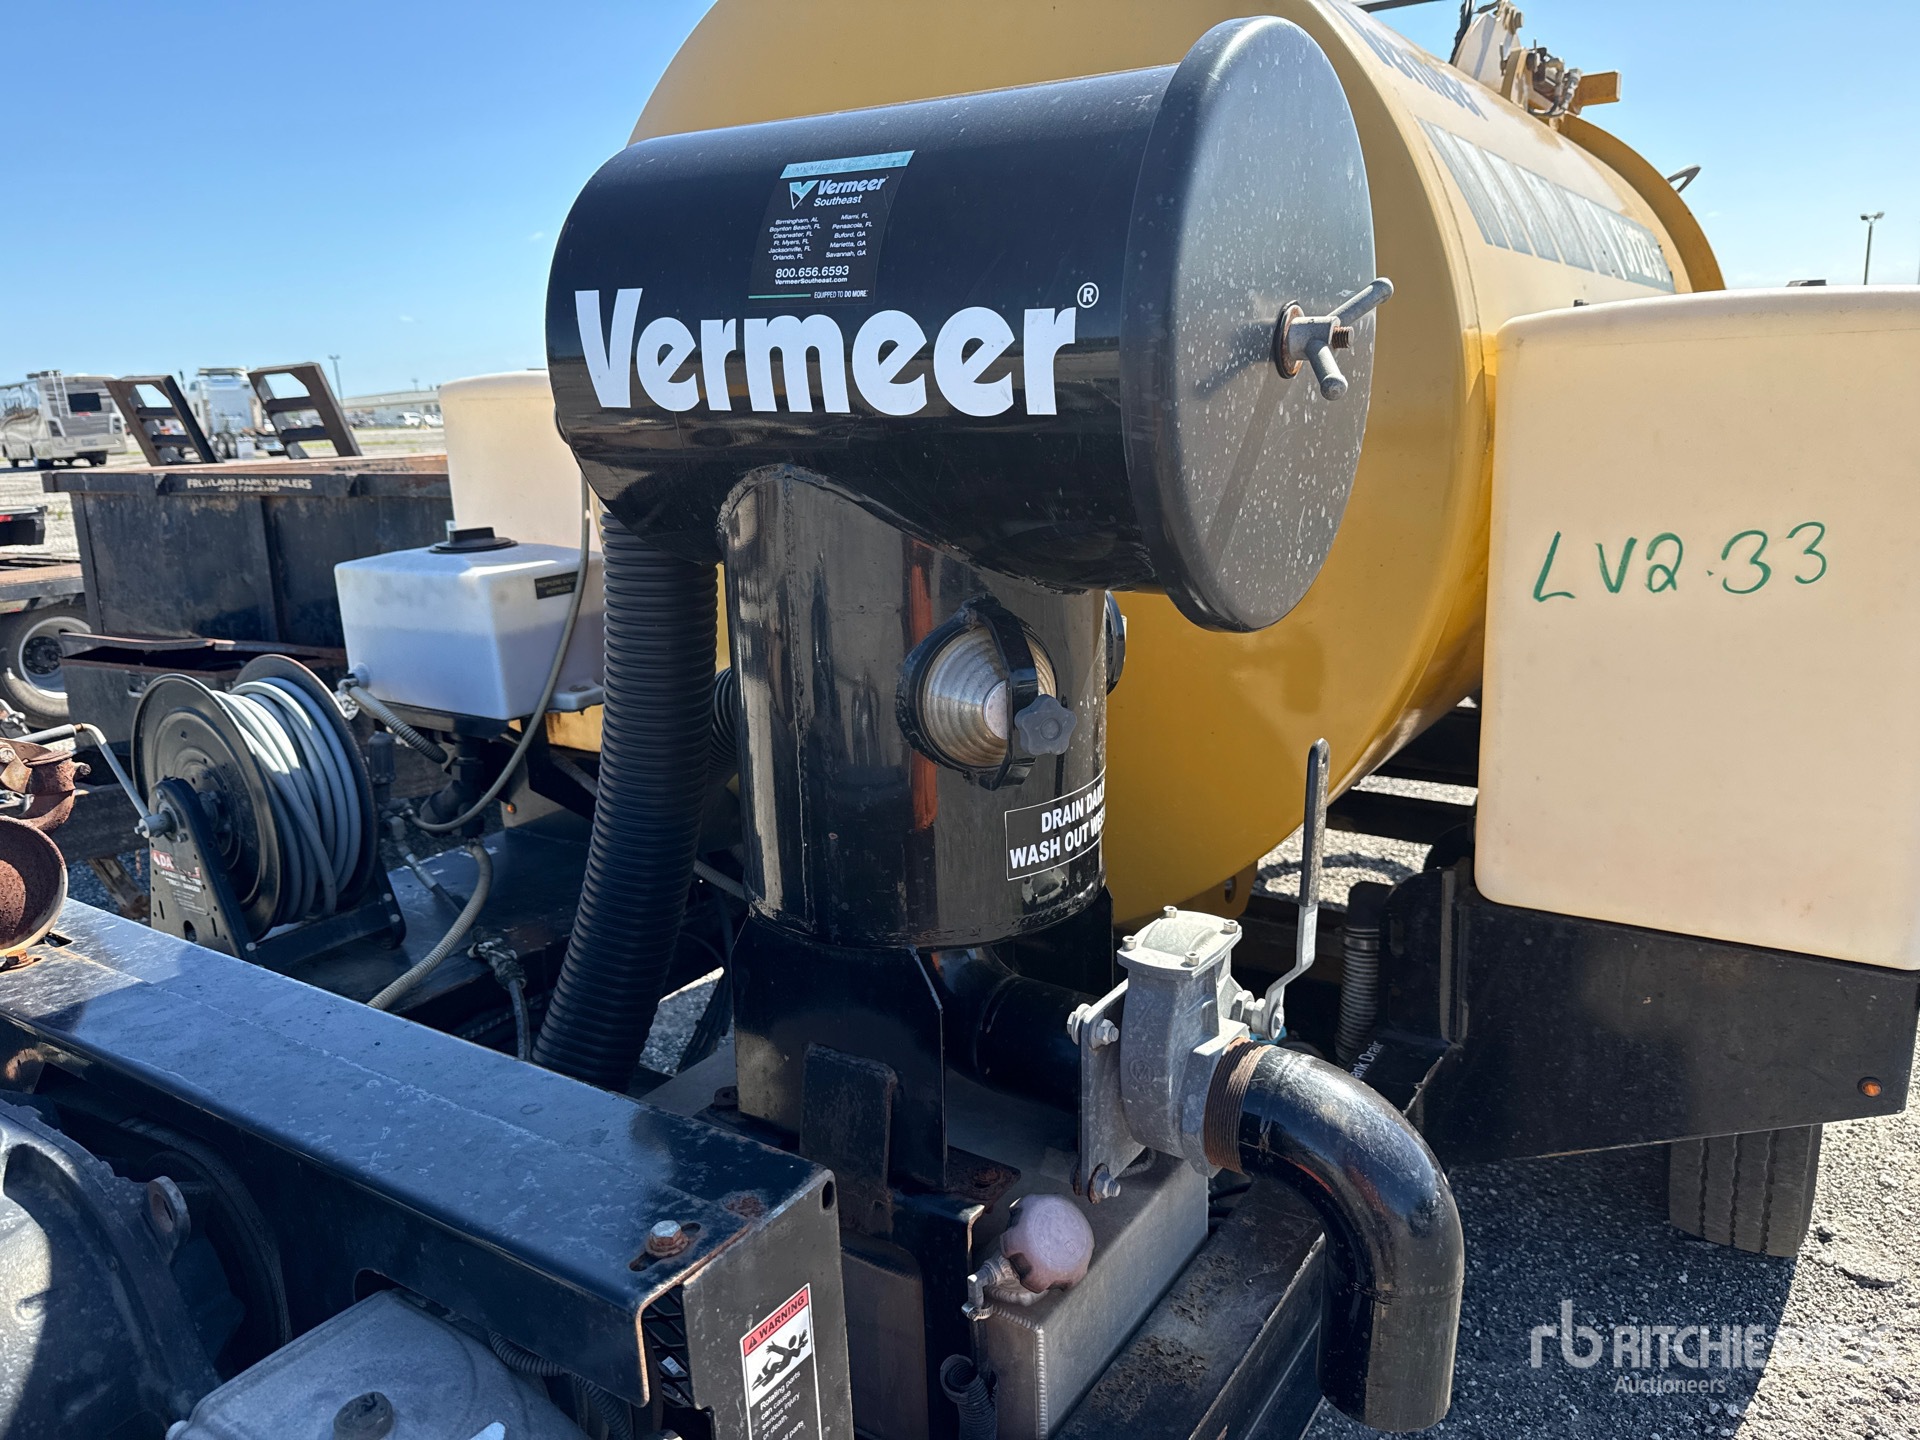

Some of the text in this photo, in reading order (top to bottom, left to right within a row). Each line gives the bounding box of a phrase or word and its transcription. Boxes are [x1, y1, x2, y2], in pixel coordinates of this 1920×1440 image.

[818, 178, 885, 196] Vermeer
[814, 195, 862, 207] Southeast
[775, 218, 810, 226] Birmingham,
[832, 222, 864, 230] Pensacola,
[768, 246, 802, 254] Jacksonville,
[775, 265, 850, 279] 800.656.6593
[774, 277, 848, 286] VermeerSoutheast.com
[814, 291, 836, 299] EQUIPPED
[838, 290, 844, 298] TO
[844, 290, 852, 298] DO
[575, 288, 1076, 416] Vermeer
[265, 478, 312, 490] TRAILERS
[1041, 798, 1084, 833] DRAIN
[1010, 837, 1060, 869] WASH
[1064, 822, 1089, 852] OUT
[1350, 1062, 1370, 1079] ank
[759, 1296, 805, 1339] WARNING
[760, 1371, 800, 1410] Rotating parts
[761, 1391, 792, 1420] can cause
[762, 1392, 800, 1430] serious injury
